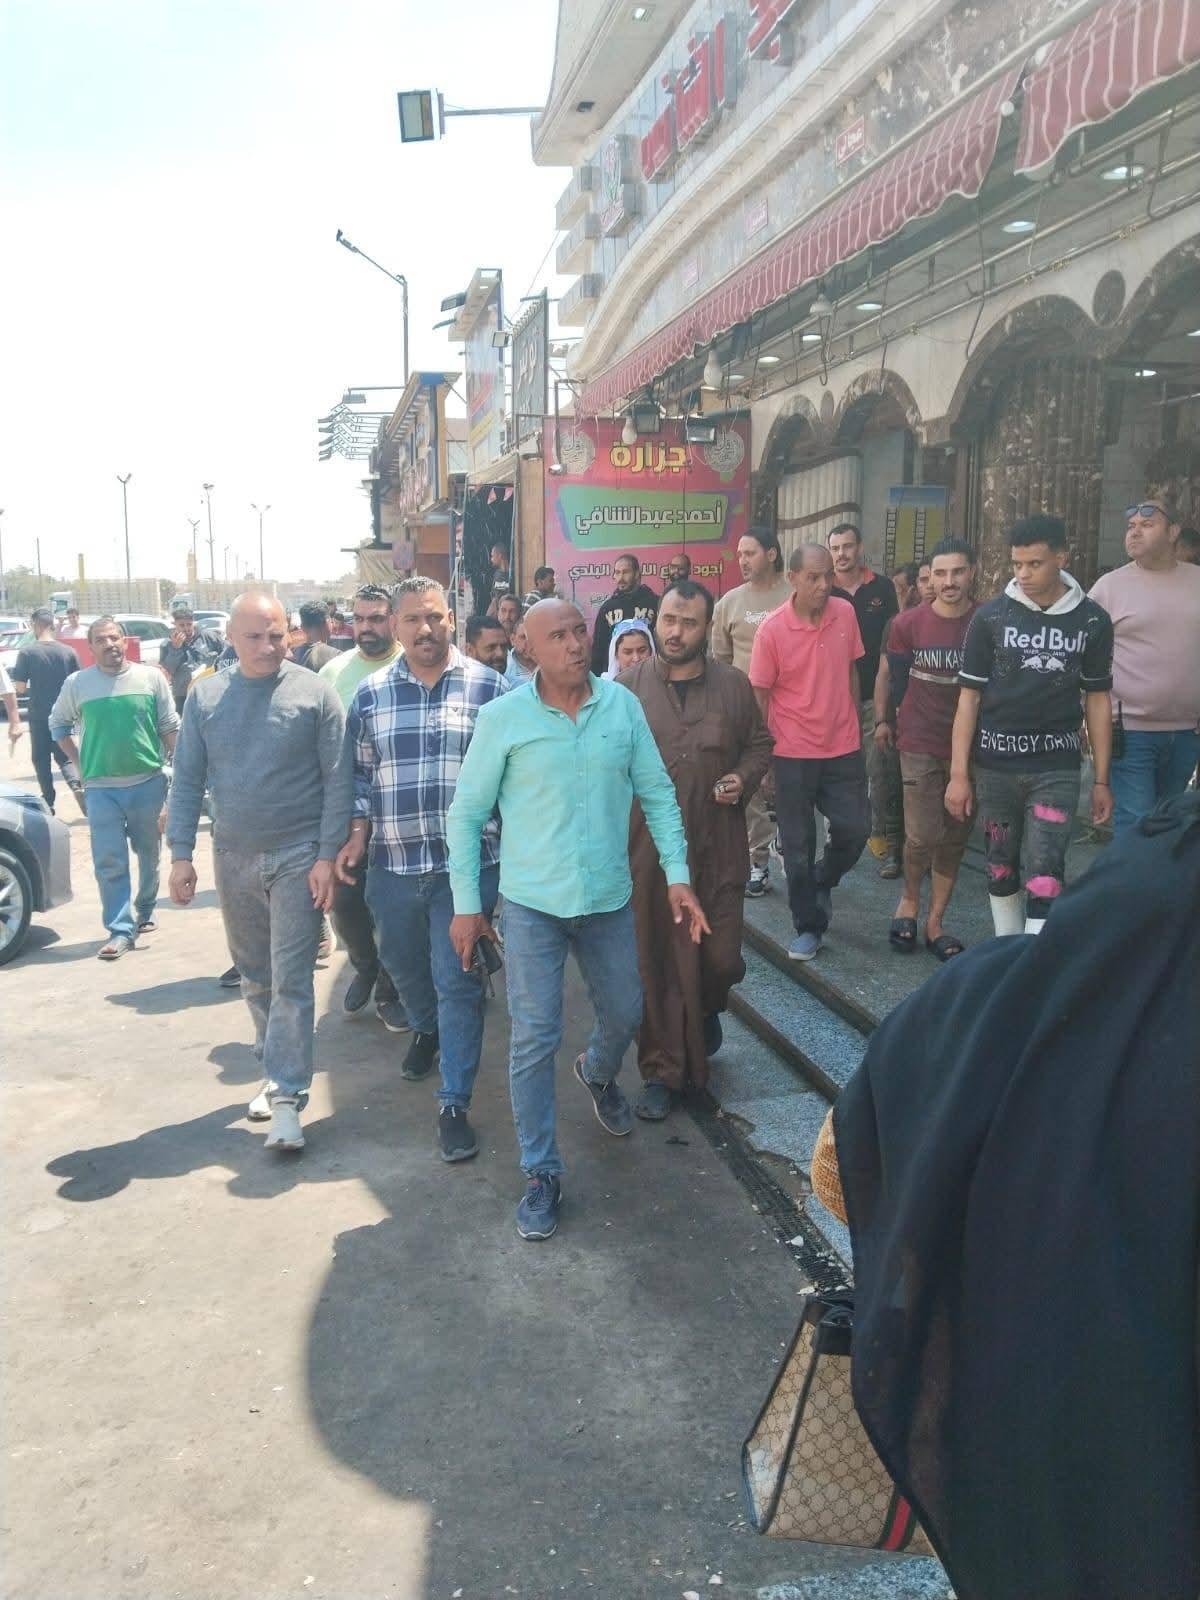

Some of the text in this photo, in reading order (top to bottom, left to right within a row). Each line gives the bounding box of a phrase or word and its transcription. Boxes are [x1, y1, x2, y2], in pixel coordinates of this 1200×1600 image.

[609, 441, 687, 473] جزارة
[677, 501, 722, 525] أحمد
[568, 563, 611, 581] البلدي
[1003, 626, 1089, 653] Red Bull
[980, 729, 1040, 753] ENERGY
